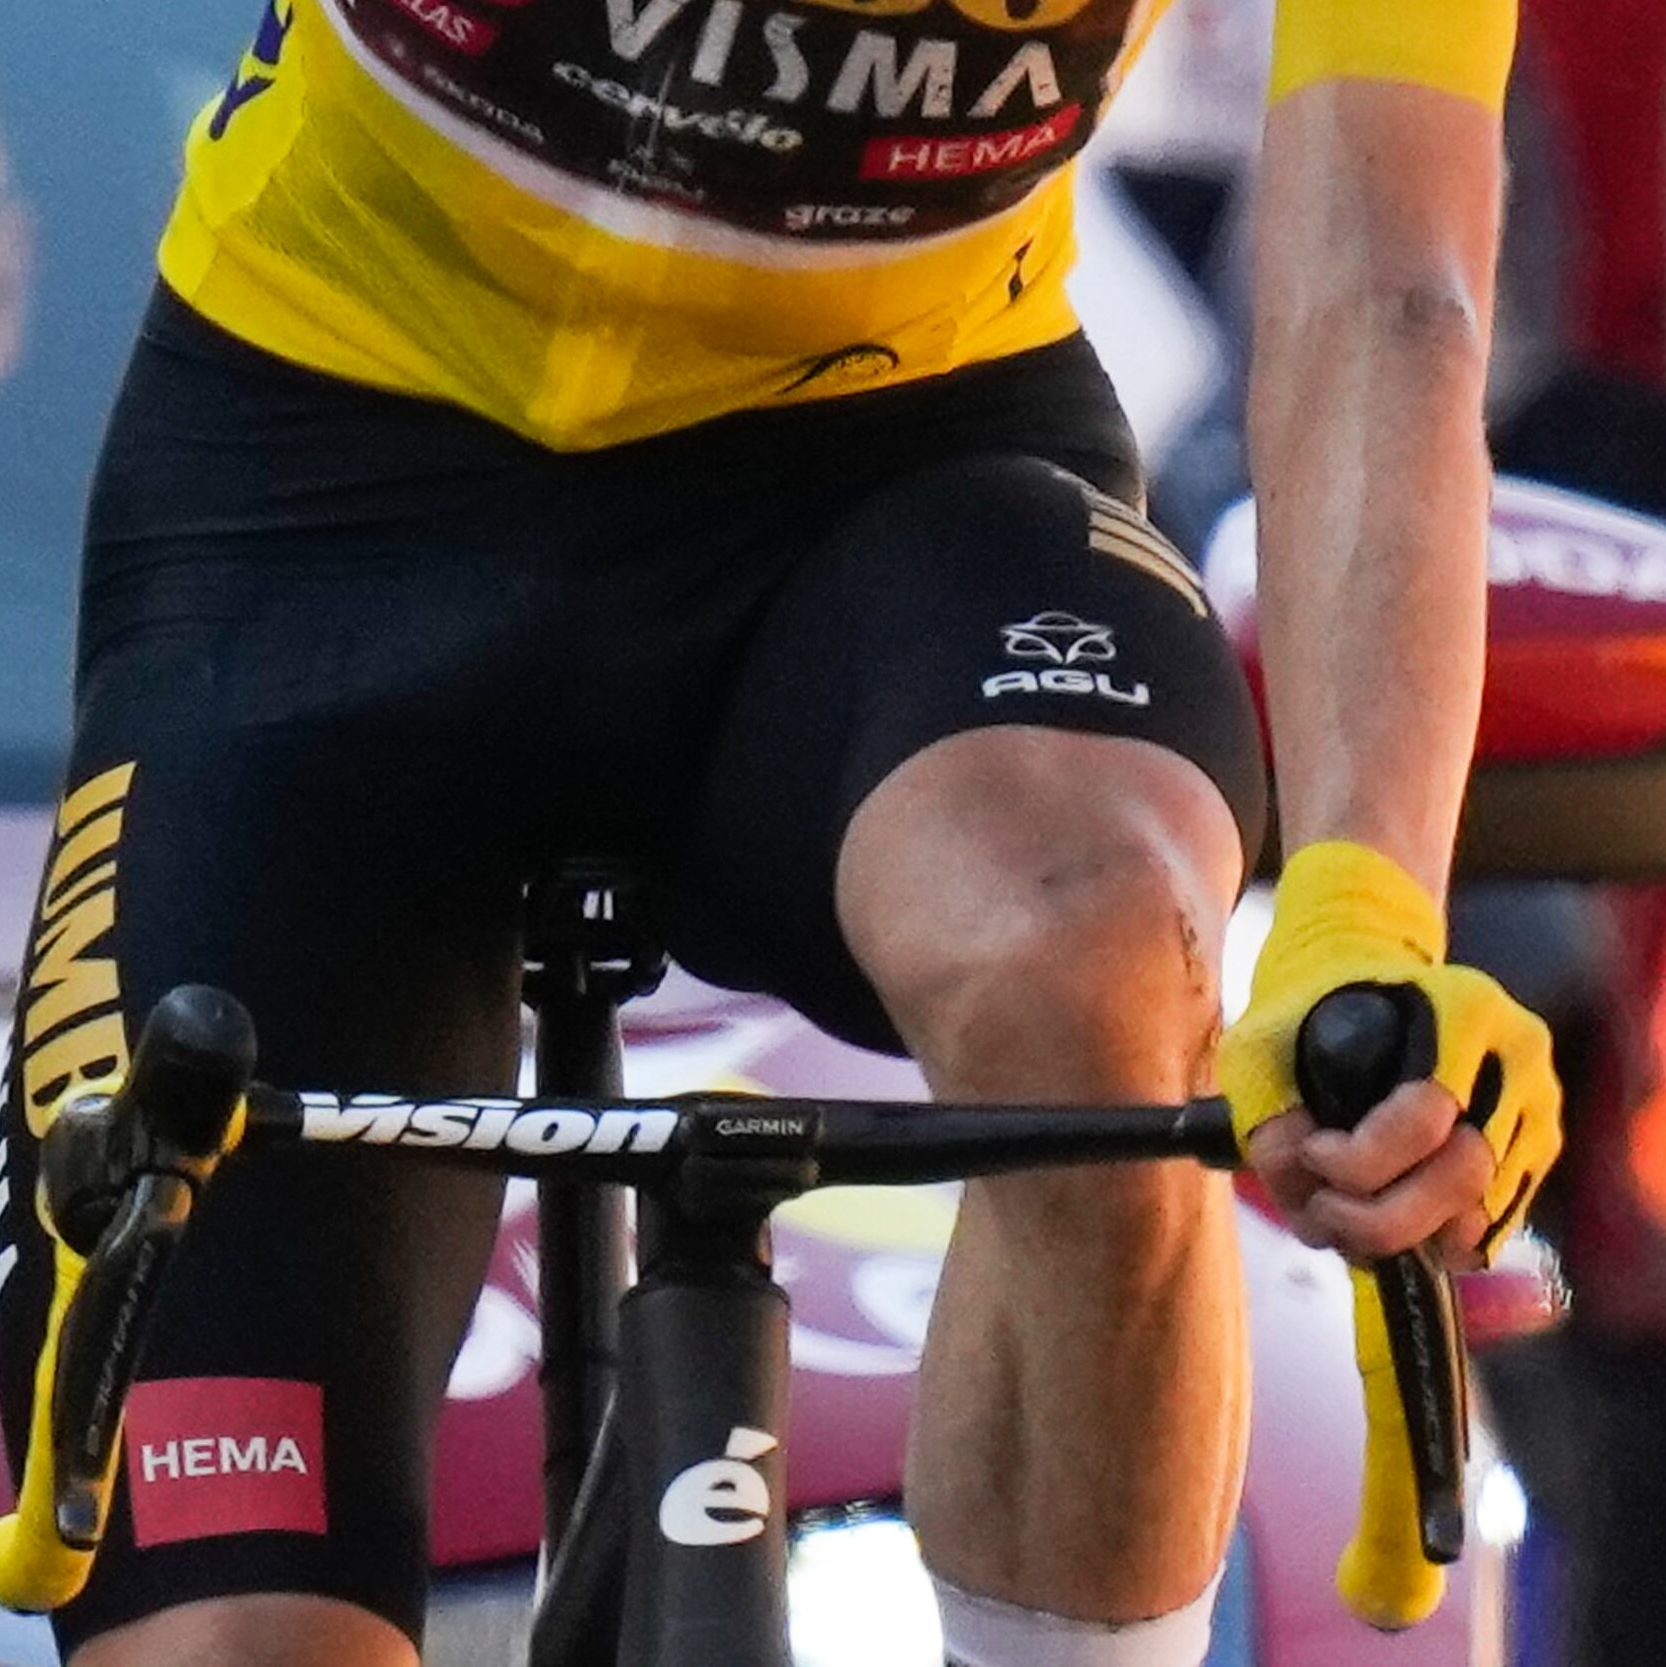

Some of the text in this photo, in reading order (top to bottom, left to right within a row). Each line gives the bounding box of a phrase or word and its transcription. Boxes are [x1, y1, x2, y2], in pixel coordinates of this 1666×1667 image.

[887, 124, 1057, 172] HEMA
[23, 761, 137, 1139] JUMB
[300, 1091, 679, 1154] vision
[715, 1118, 804, 1136] GARMIN
[141, 1435, 308, 1482] HEMA
